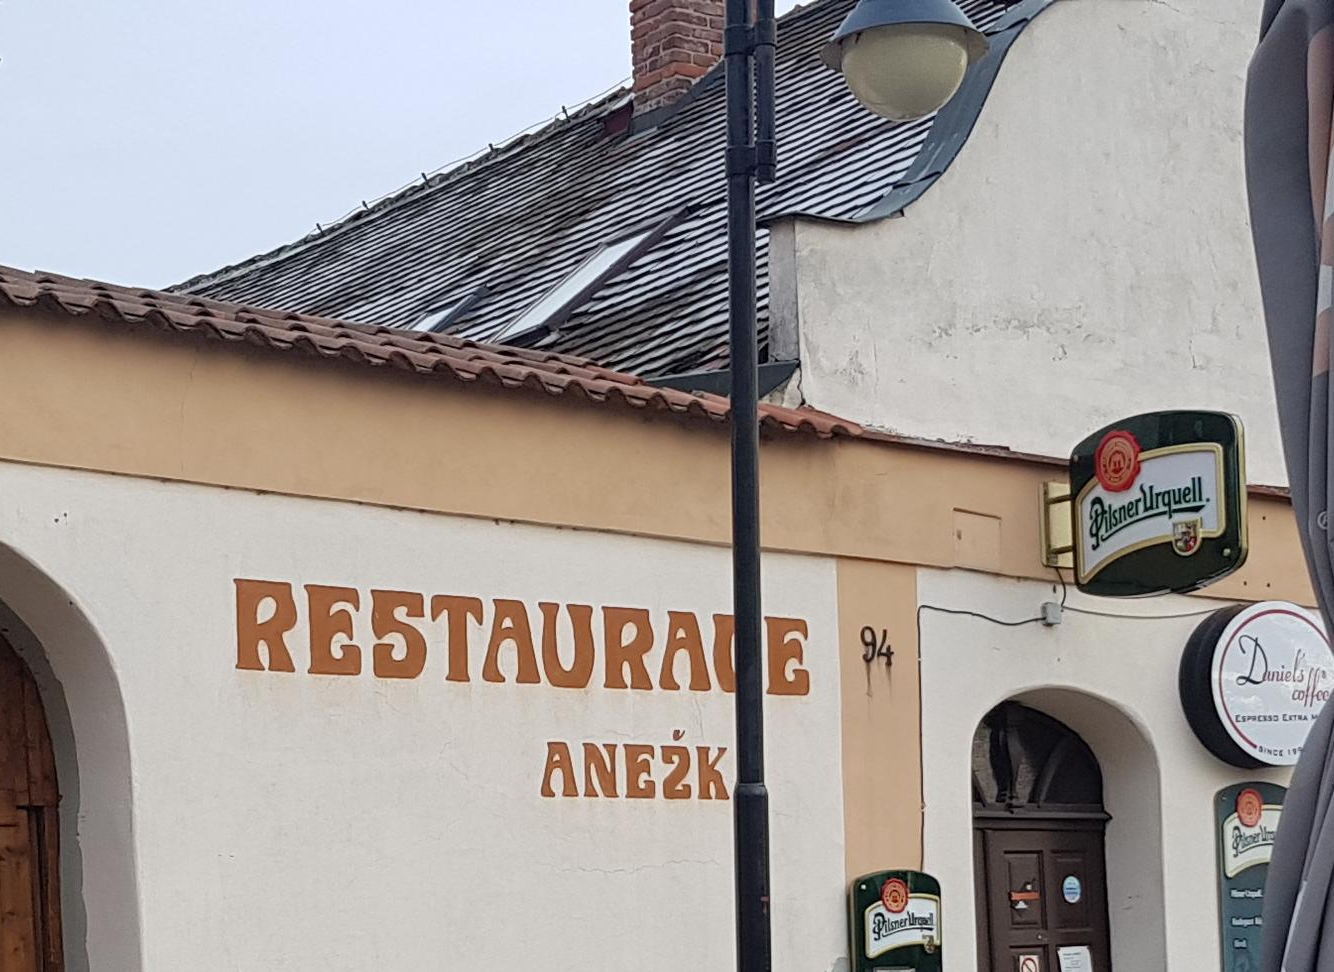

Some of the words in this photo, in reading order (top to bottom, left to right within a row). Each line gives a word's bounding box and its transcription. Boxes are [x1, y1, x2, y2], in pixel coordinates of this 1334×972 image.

[1089, 496, 1141, 551] Pilsner
[859, 626, 895, 667] 94
[1235, 634, 1305, 686] Daniel's
[1291, 667, 1330, 708] coffee
[540, 729, 731, 800] ANEŽK
[1258, 745, 1284, 757] SINCE
[873, 911, 909, 942] Pilsner
